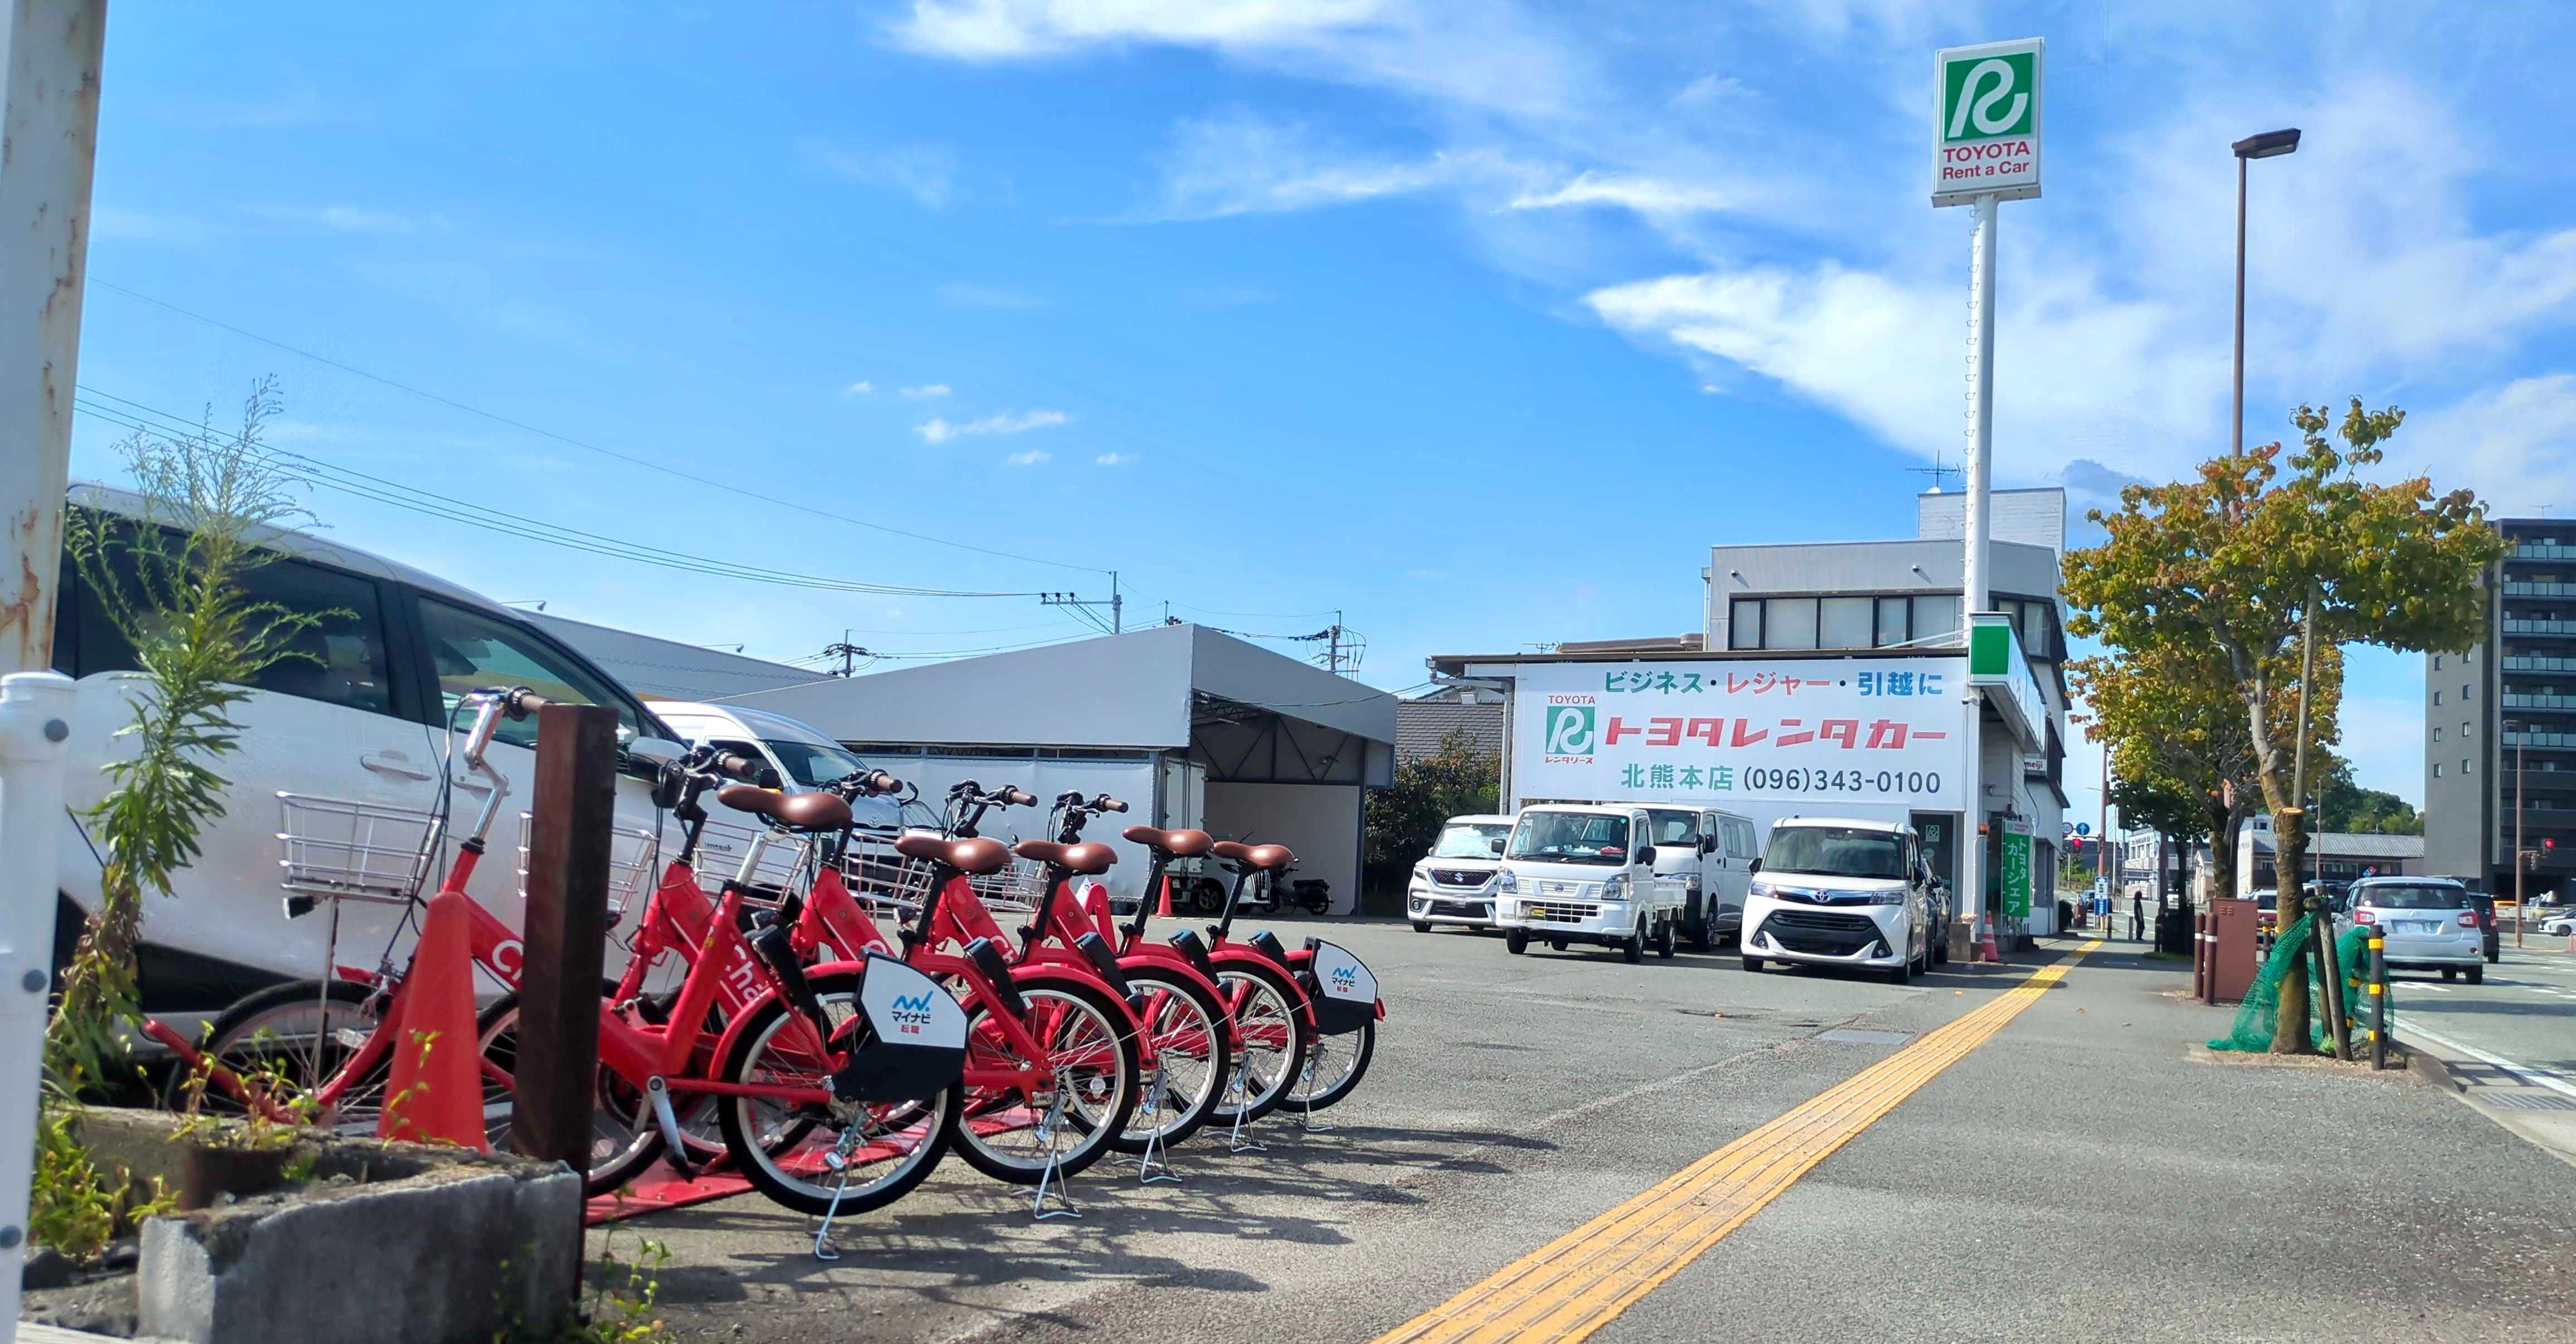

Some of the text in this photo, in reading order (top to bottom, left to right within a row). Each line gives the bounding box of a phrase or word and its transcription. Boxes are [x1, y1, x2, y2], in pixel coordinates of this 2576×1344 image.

[1943, 141, 2030, 163] TOYOTA
[1943, 161, 2029, 180] Rent a Car
[1605, 671, 1943, 696] ビジネス・レジャー・引越に
[1548, 695, 1596, 705] TOYOTA
[1605, 716, 1946, 749] トヨタレンタカー
[2023, 760, 2043, 770] meiji
[1621, 763, 1941, 794] 北熊本店 (096)343-0100
[2018, 838, 2027, 879] トヨタ
[2008, 843, 2021, 913] カーシェア
[1332, 977, 1355, 987] マイナビ
[891, 1011, 931, 1024] マイナビ
